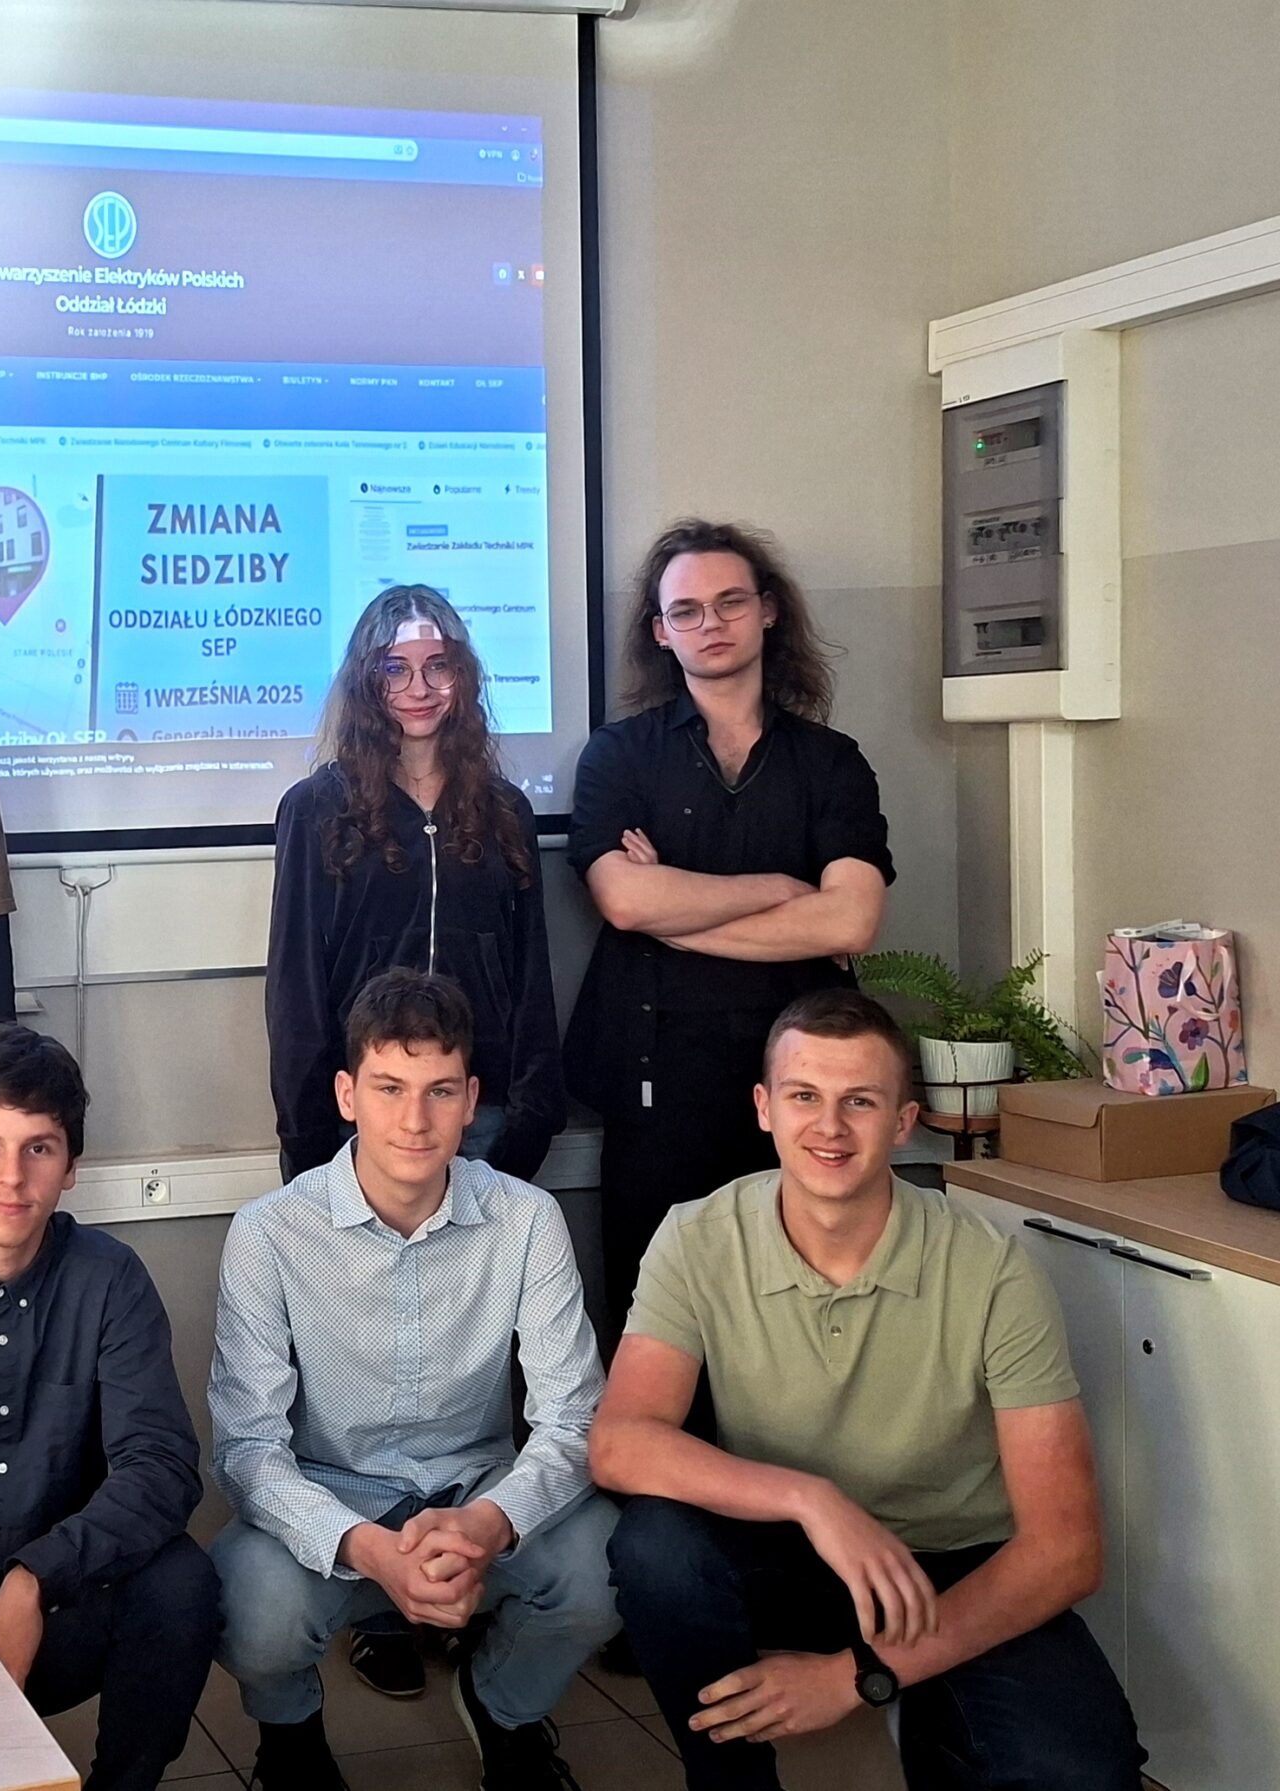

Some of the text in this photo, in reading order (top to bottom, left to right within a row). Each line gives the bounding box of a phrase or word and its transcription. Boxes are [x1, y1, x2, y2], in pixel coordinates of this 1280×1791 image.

[92, 194, 132, 253] SEP
[95, 267, 180, 288] Elektryków
[182, 270, 245, 288] Polskich
[55, 295, 167, 315] Oddział Łódzki
[67, 326, 85, 336] Rok
[36, 371, 88, 381] INSTRUKCJE
[130, 371, 170, 382] OŚRODEK
[283, 375, 323, 385] BIULETYN
[419, 378, 455, 388] KONTAKT
[370, 484, 411, 495] Najnowsze
[445, 485, 482, 496] Popularne
[516, 485, 541, 496] Trendy
[147, 503, 282, 535] ZMIANA
[141, 552, 290, 585] SIEDZIBY
[455, 604, 536, 614] arodowego Centrum
[109, 604, 322, 629] ODDZIAŁU ŁÓDZKIEGO
[201, 637, 237, 657] SEP
[144, 680, 303, 708] 1 WRZEŚNIA 2025
[152, 725, 224, 741] Generała
